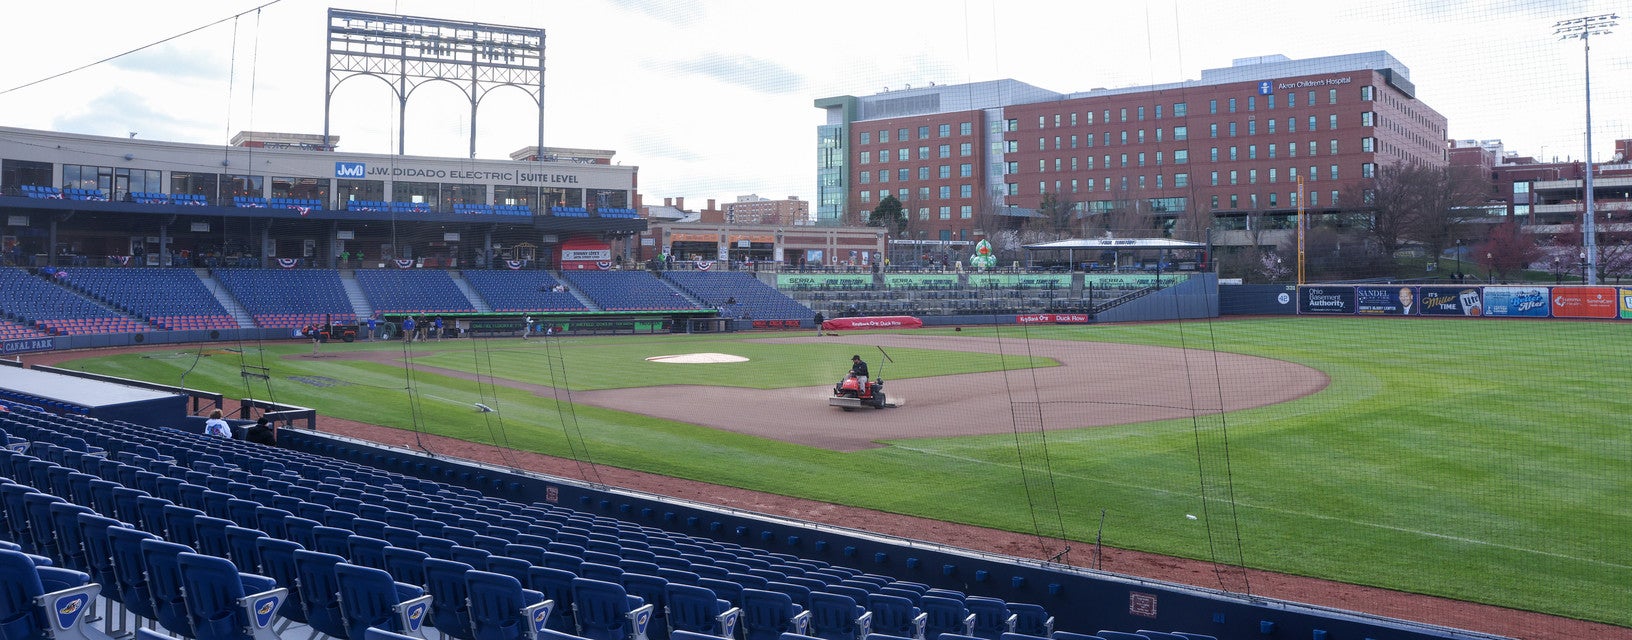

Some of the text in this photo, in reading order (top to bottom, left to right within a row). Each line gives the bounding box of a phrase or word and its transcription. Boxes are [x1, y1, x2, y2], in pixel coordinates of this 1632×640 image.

[1296, 80, 1325, 88] Children's
[1326, 77, 1351, 86] Hospital
[368, 167, 579, 184] J.W. DIDADO ELECTRIC SUITE LEVEL
[1422, 296, 1456, 309] Miller
[1511, 296, 1543, 306] Better
[1518, 301, 1544, 311] After
[6, 340, 52, 350] CANAL PARK
